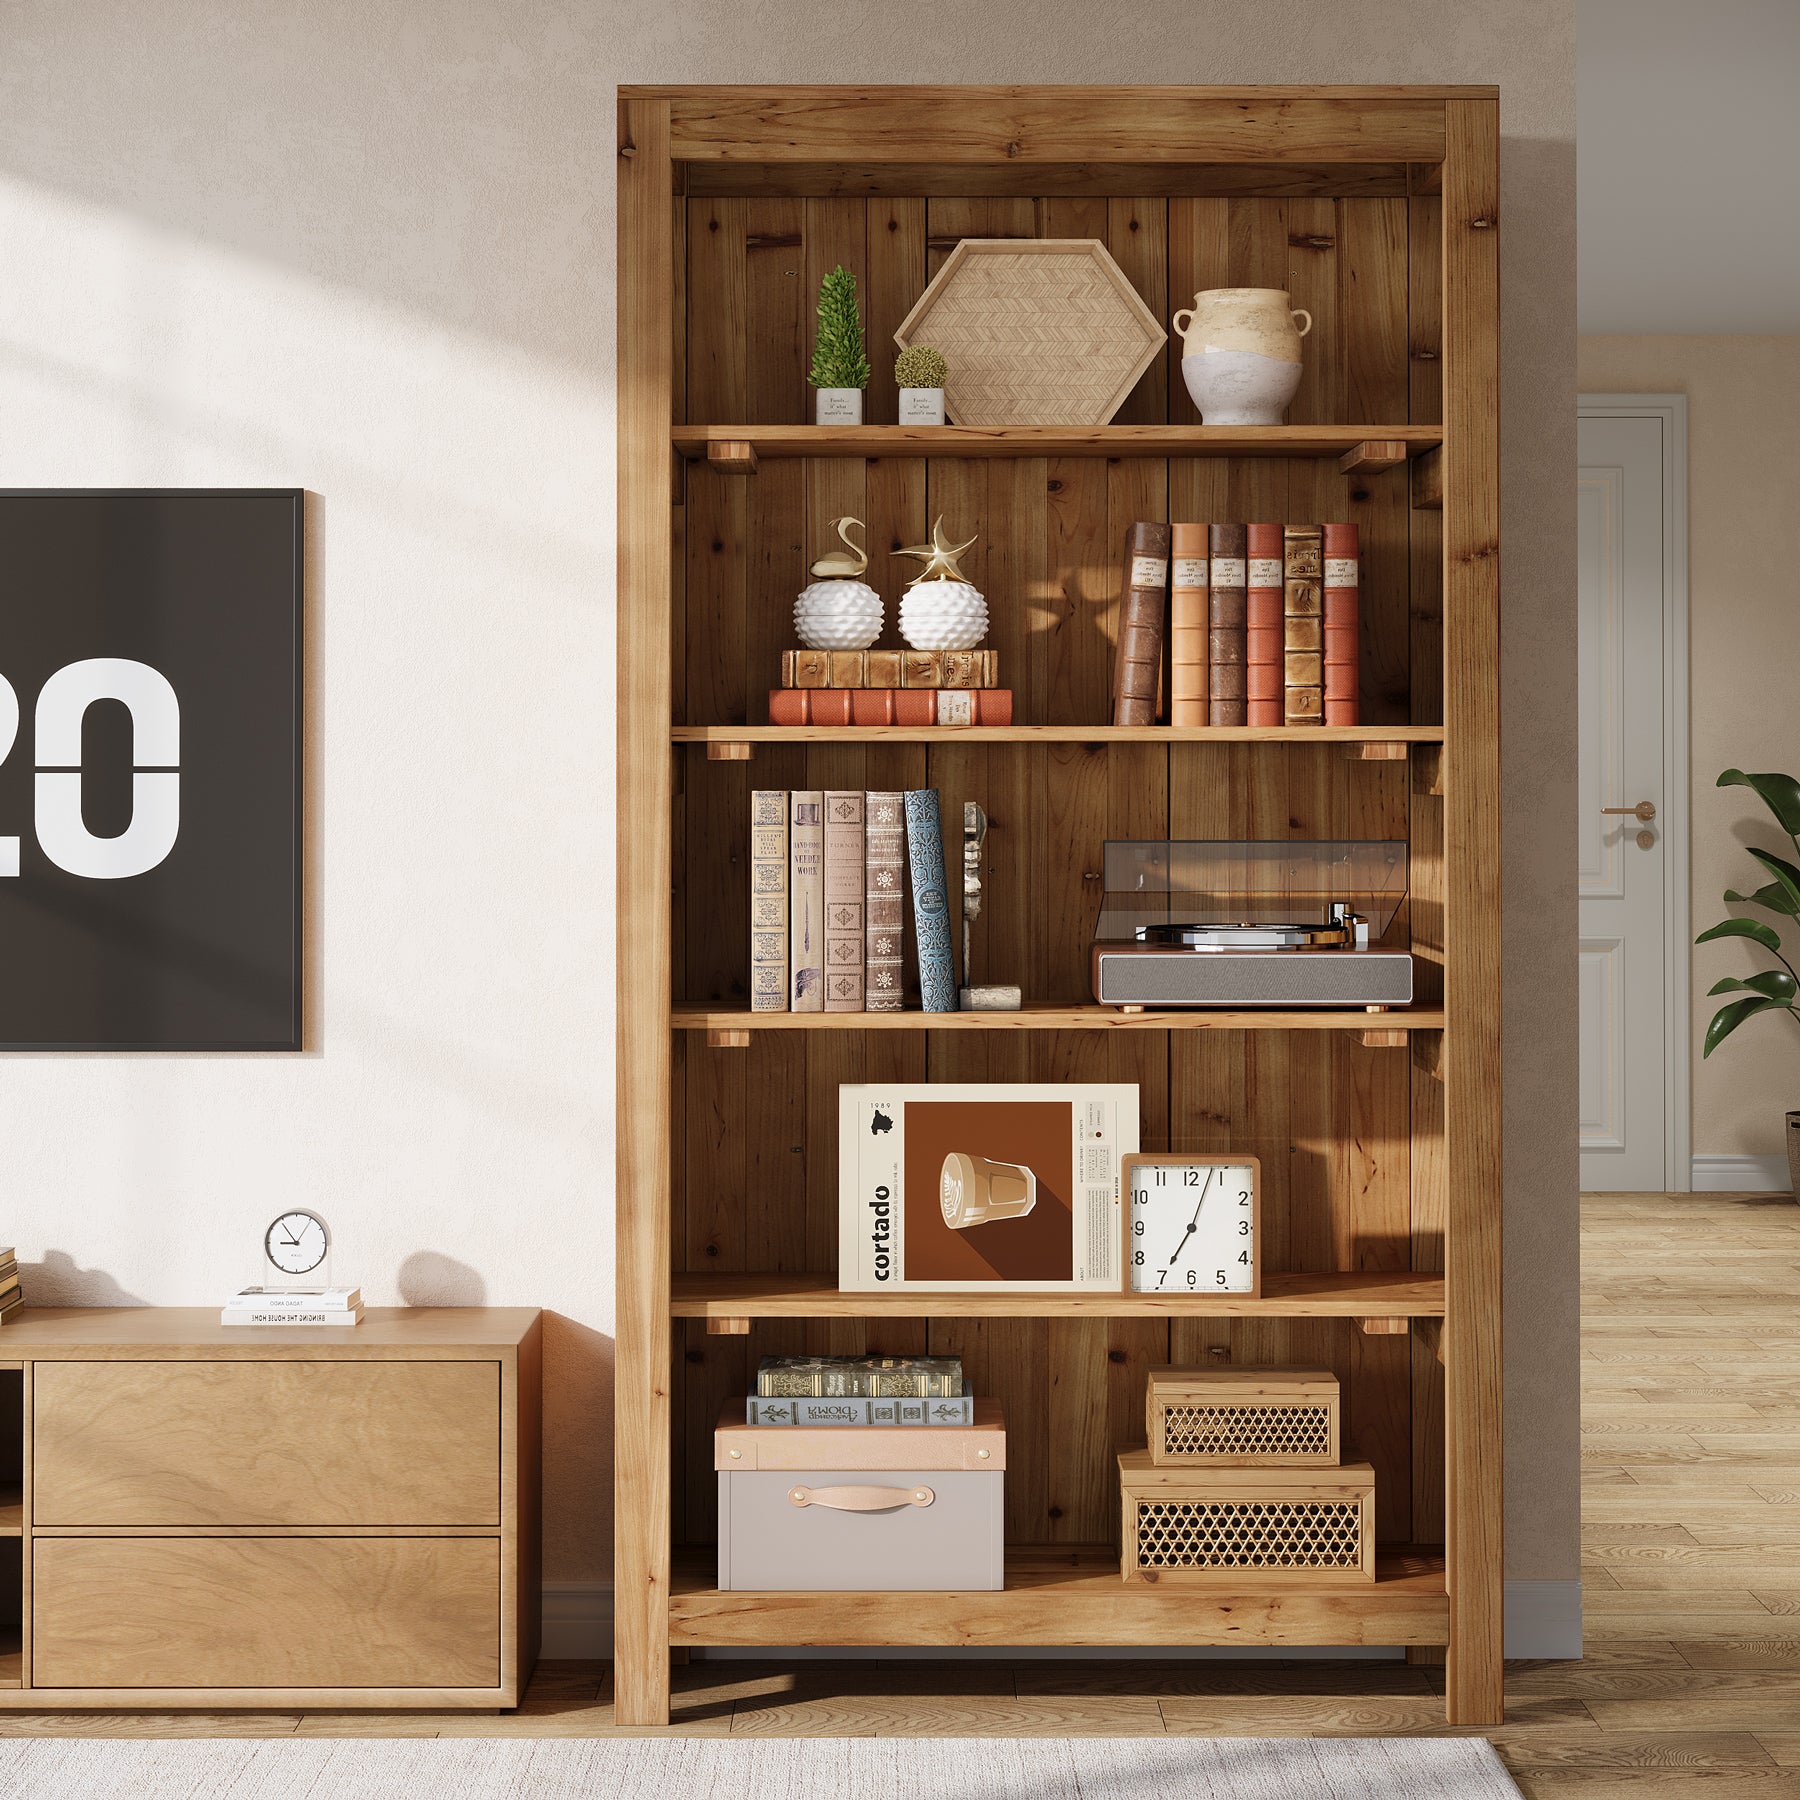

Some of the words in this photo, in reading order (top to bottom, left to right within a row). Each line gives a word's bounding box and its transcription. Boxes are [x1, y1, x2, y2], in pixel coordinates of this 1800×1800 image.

[0, 658, 180, 880] 0
[797, 866, 818, 875] WORK
[1156, 1171, 1166, 1186] 11
[1183, 1171, 1199, 1186] 12
[1219, 1171, 1223, 1186] 1
[1134, 1189, 1148, 1204] 10
[1238, 1191, 1249, 1206] 2
[868, 1185, 890, 1282] cortado
[1134, 1221, 1144, 1236] 9
[1238, 1221, 1249, 1236] 3
[1134, 1250, 1145, 1265] 8
[1237, 1250, 1249, 1265] 4
[1156, 1270, 1167, 1285] 7
[1186, 1270, 1197, 1285] 6
[1216, 1270, 1226, 1285] 5
